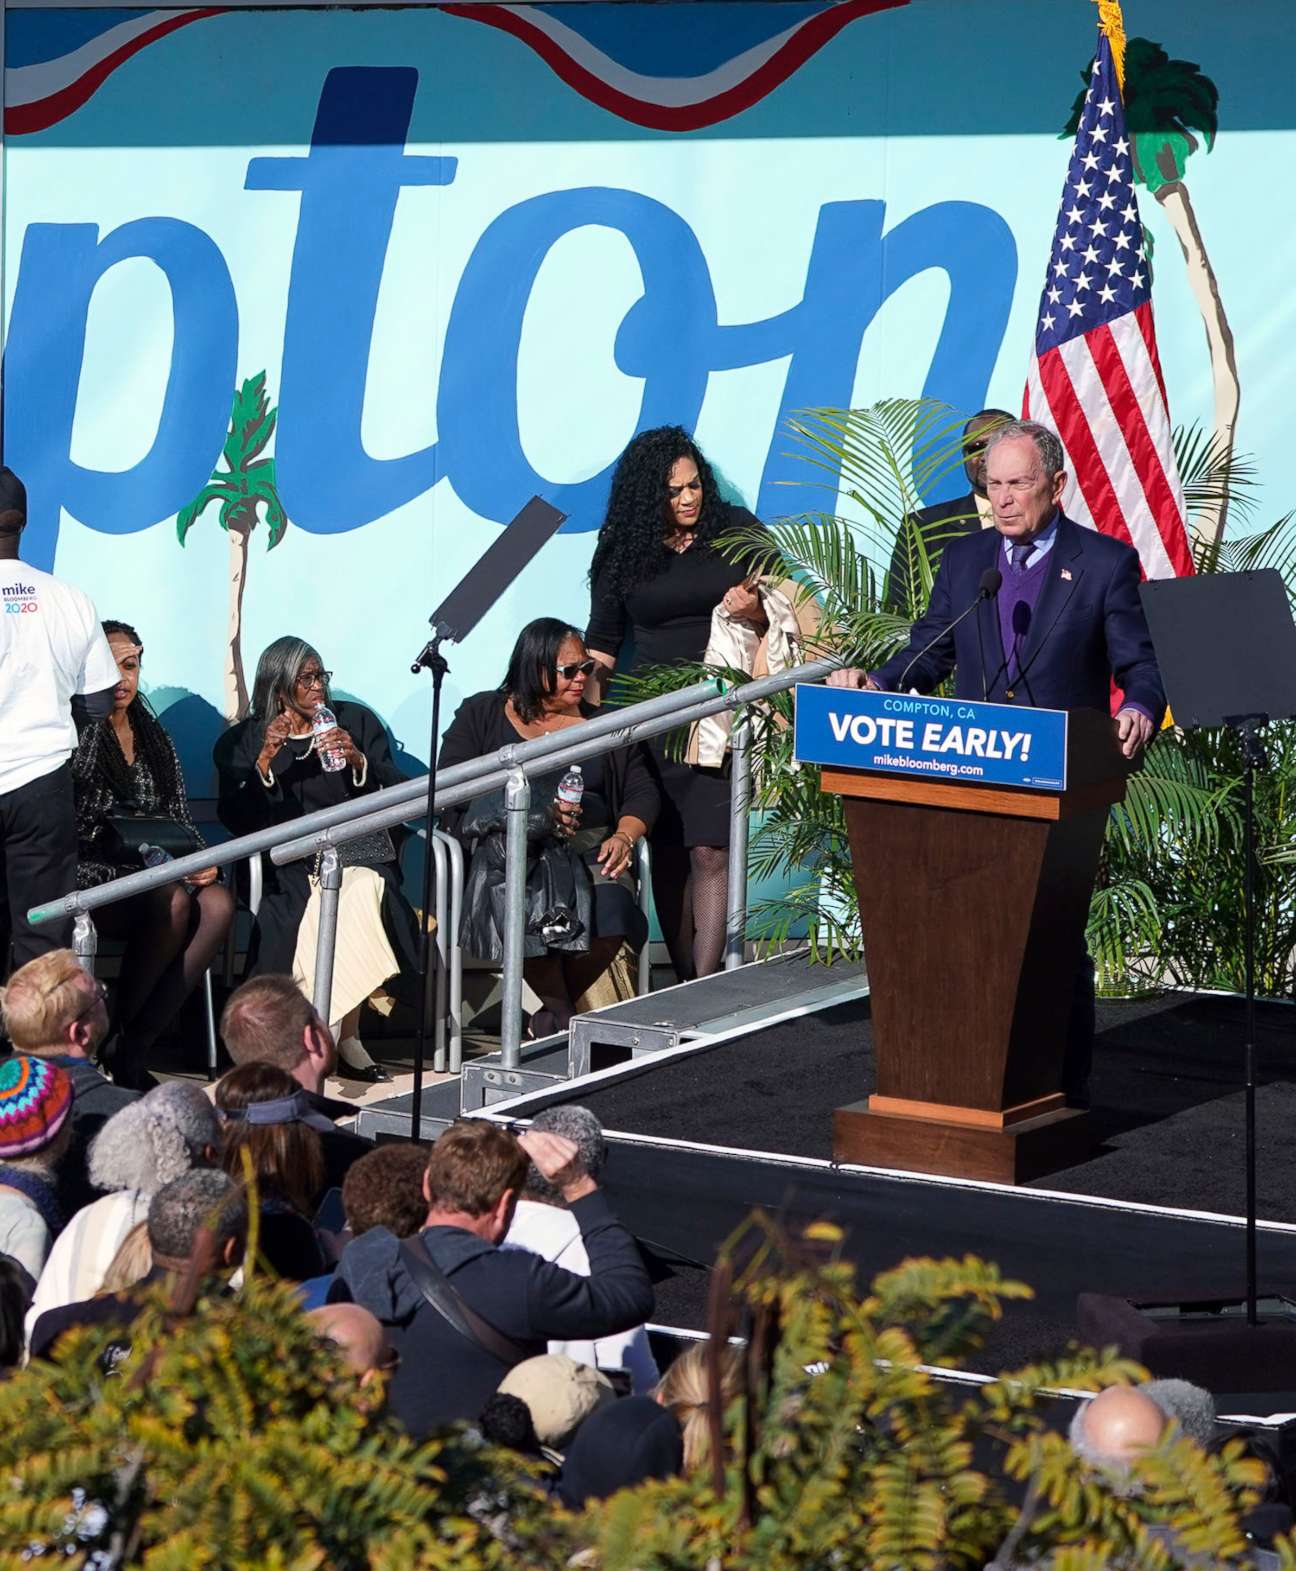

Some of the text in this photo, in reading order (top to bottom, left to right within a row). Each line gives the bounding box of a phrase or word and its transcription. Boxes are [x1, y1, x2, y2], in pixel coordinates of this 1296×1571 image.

[2, 582, 35, 595] mike
[5, 602, 38, 613] 2020
[883, 699, 976, 720] COMPTON, CA
[828, 712, 1032, 762] VOTE EARLY!
[873, 754, 984, 776] mikebloomberg.com
